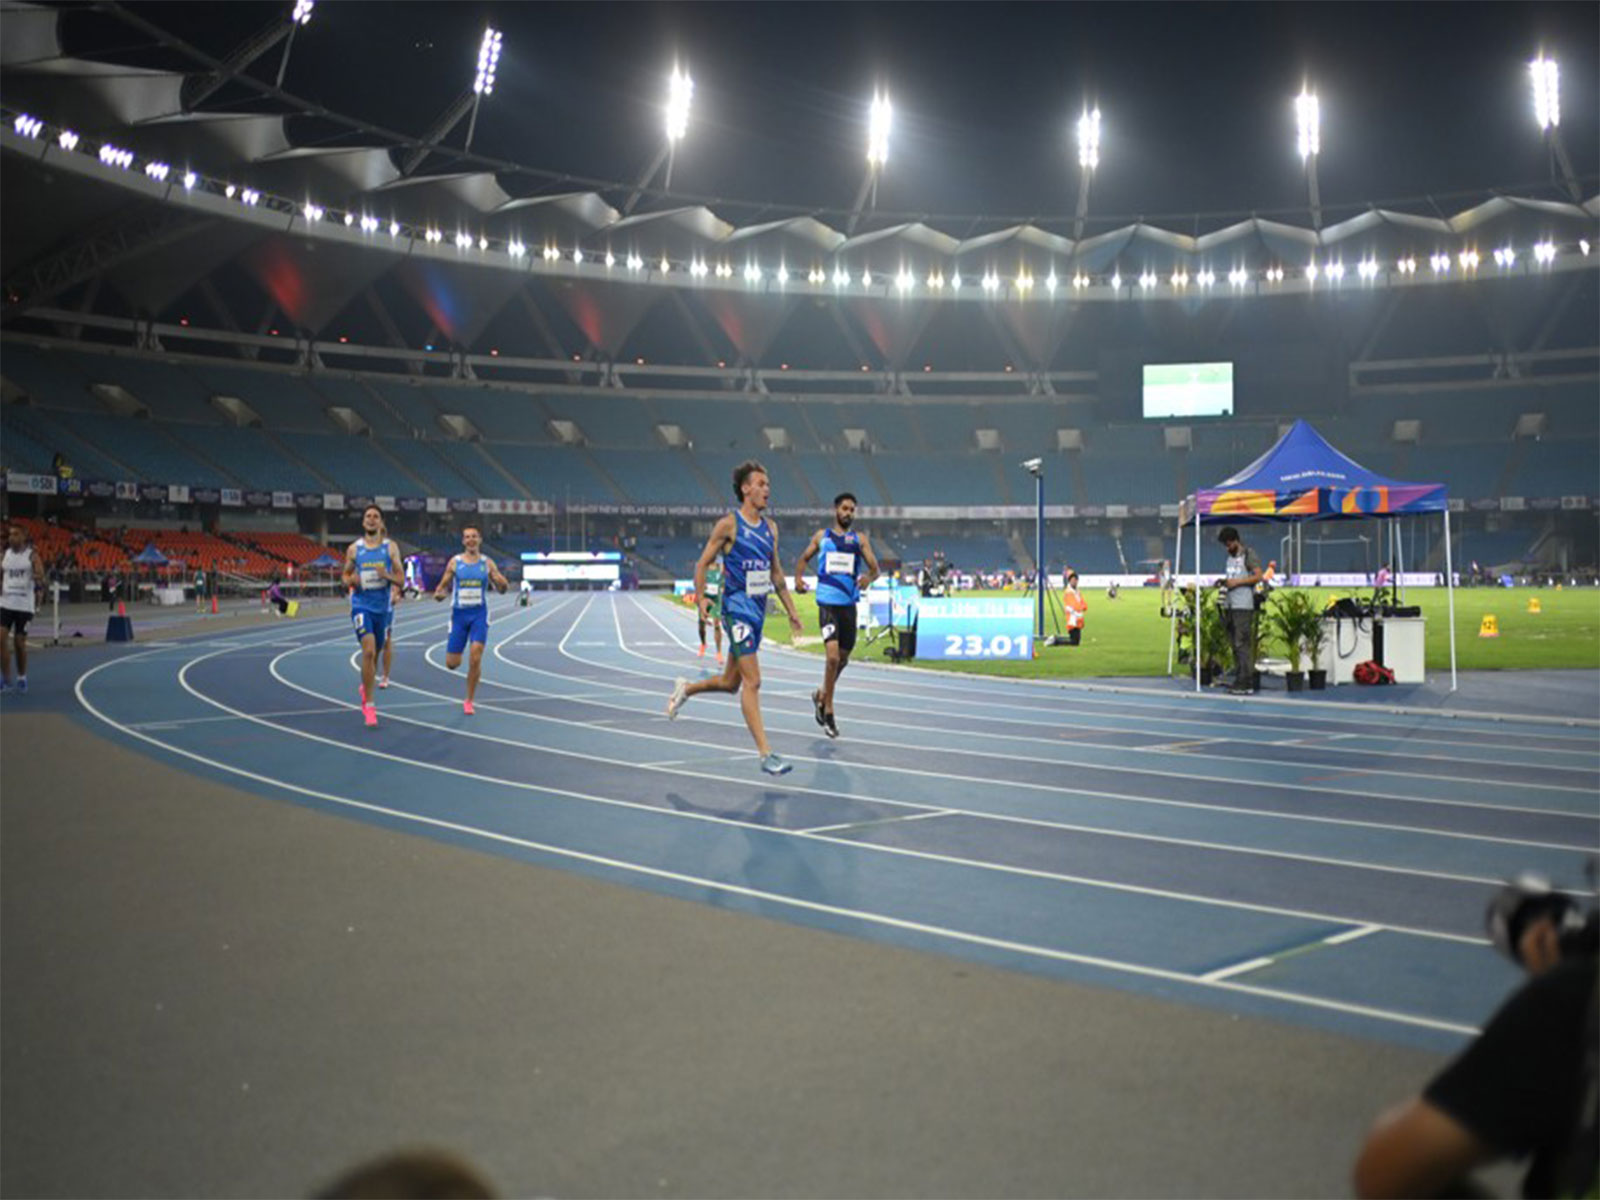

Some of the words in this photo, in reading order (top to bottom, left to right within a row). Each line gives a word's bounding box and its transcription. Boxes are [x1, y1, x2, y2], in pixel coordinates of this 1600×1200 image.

[599, 505, 619, 514] NEW
[620, 505, 645, 515] DELHI
[647, 506, 667, 515] 2025
[668, 506, 700, 516] WORLD
[701, 506, 724, 516] PARA
[736, 625, 745, 640] 7
[944, 634, 1029, 657] 23.01
